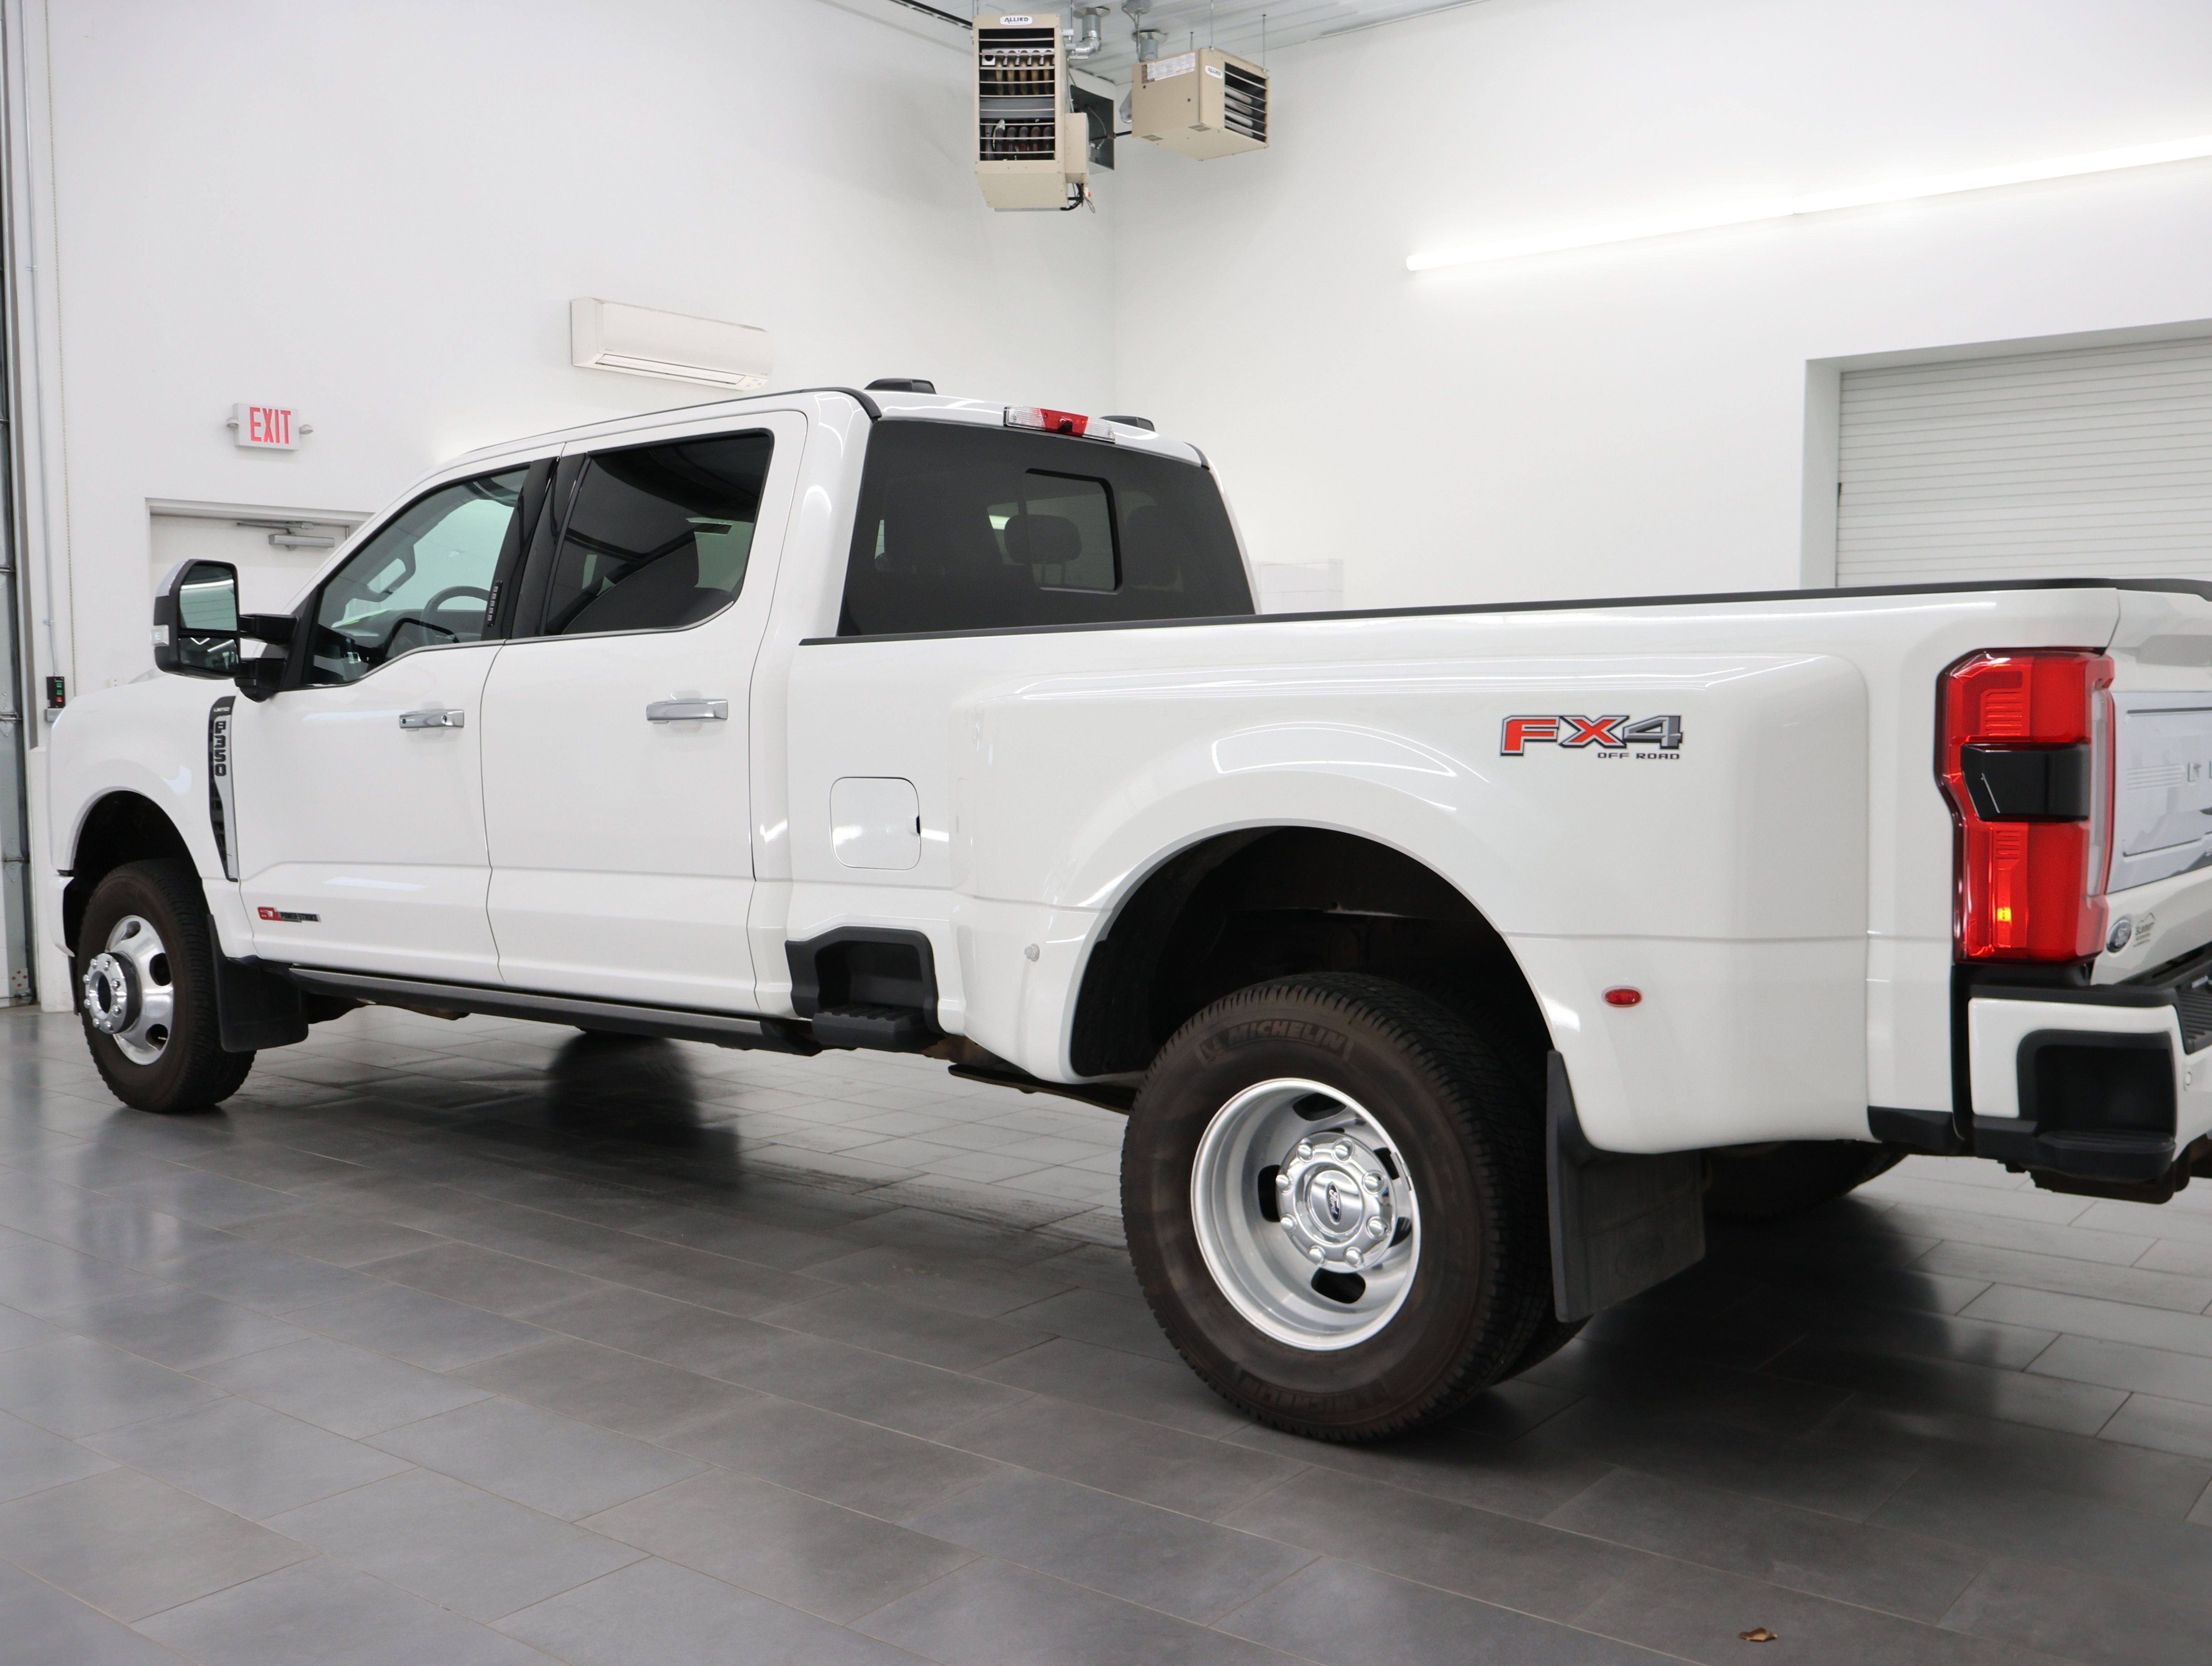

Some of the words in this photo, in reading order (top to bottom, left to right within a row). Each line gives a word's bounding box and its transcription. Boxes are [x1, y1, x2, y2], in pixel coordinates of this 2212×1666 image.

[250, 406, 291, 444] EXIT
[1500, 715, 1682, 756] FX4
[1229, 1020, 1347, 1050] MICHELIN
